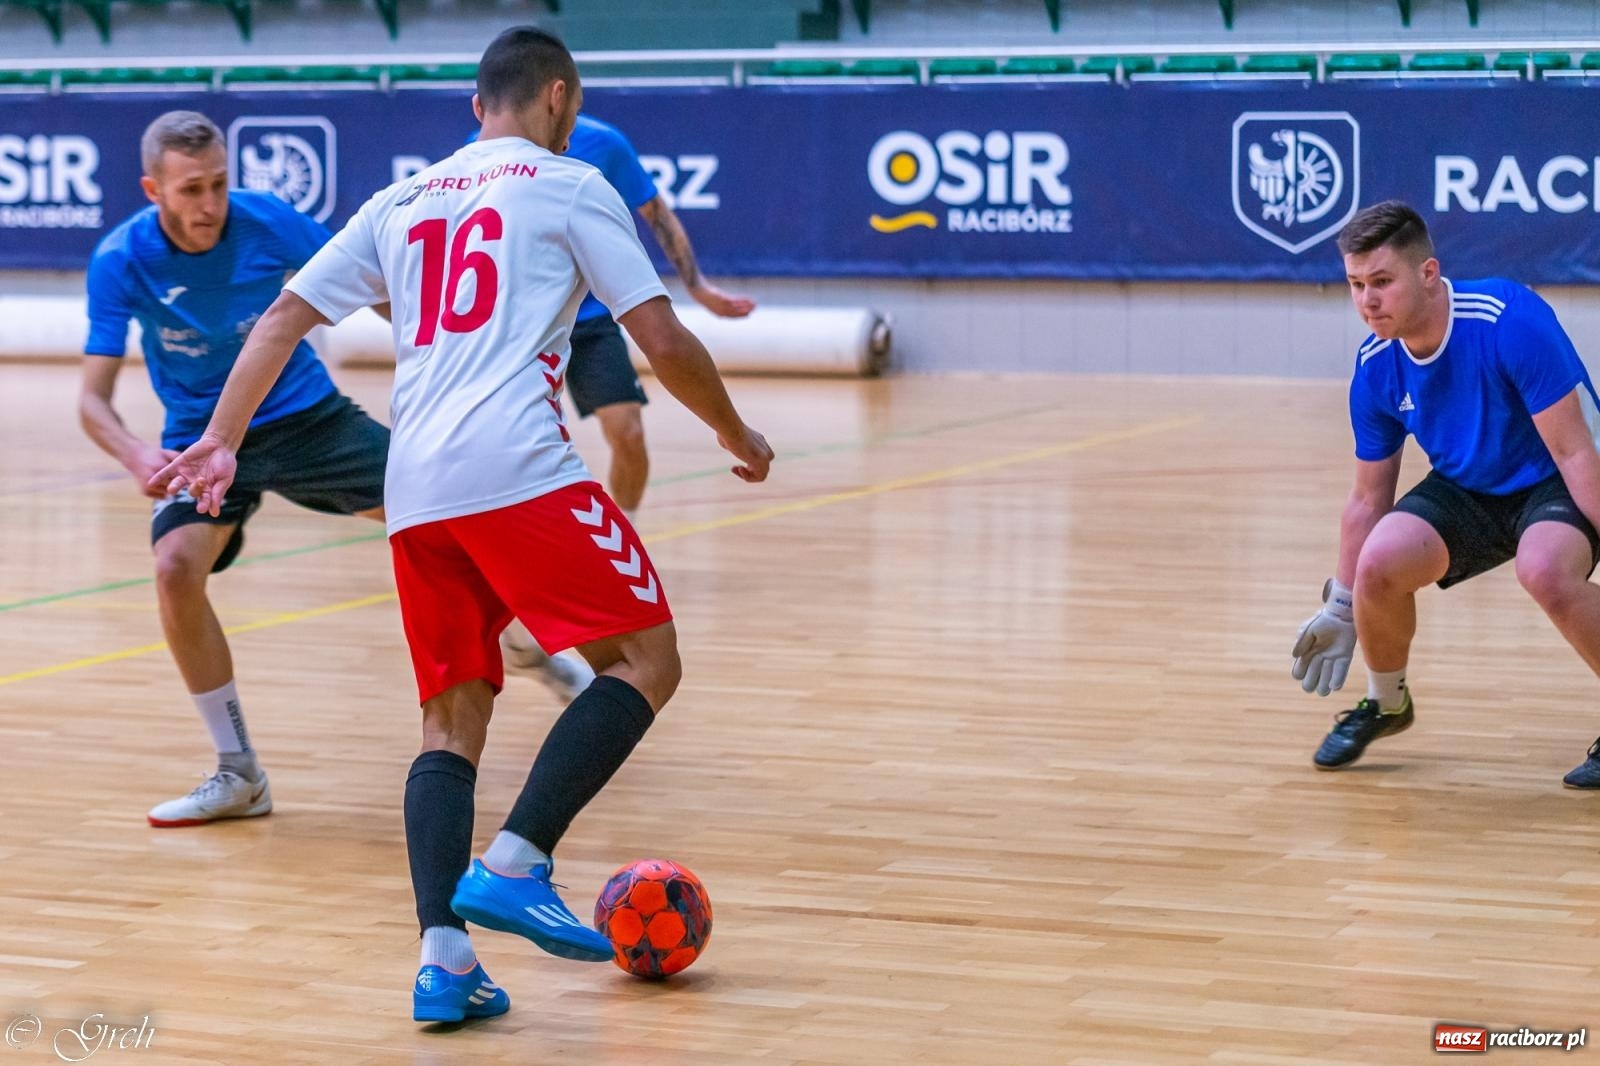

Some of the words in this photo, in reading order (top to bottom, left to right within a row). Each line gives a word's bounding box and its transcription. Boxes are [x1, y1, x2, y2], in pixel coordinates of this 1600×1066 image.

[867, 130, 1073, 205] OSiR
[948, 204, 1073, 233] RACIBÓRZ
[407, 207, 504, 347] 16
